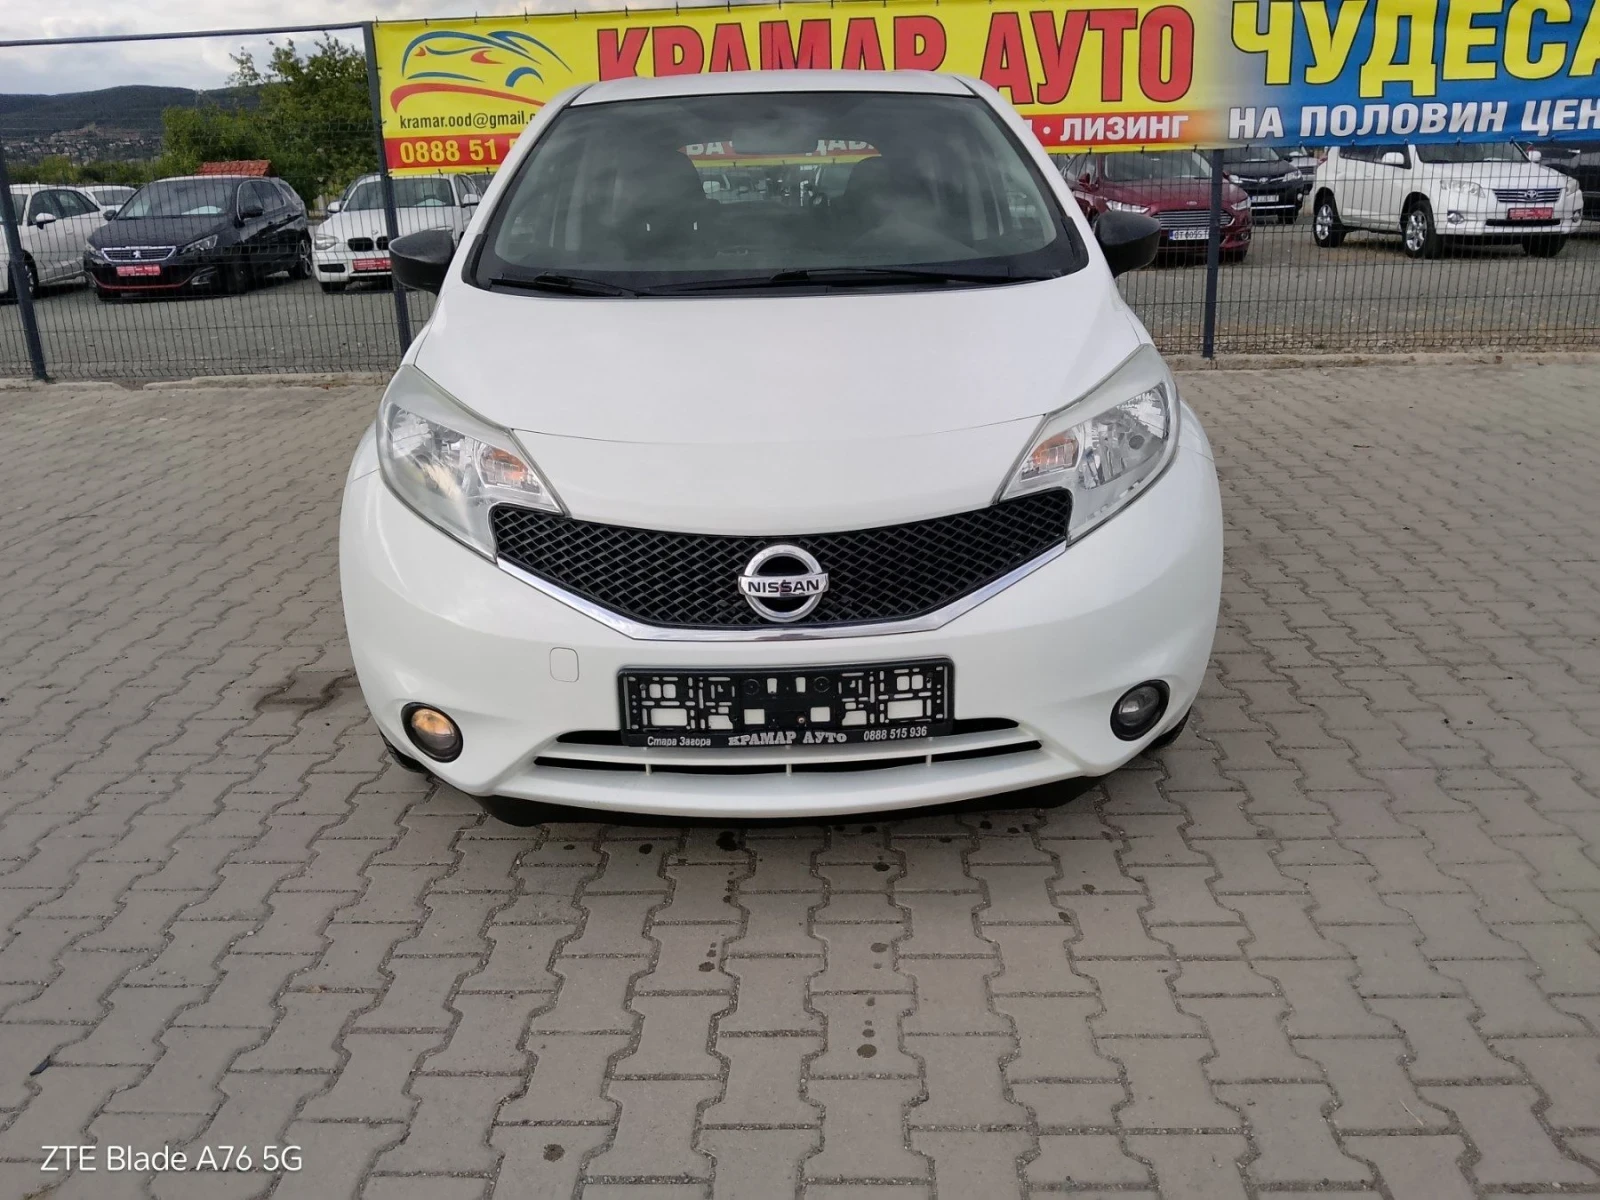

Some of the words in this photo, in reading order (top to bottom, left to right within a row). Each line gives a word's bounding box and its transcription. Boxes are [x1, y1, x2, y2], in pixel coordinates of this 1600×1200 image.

[980, 5, 1194, 104] АУТО
[1059, 116, 1189, 141] ЛИЗИНГ
[1228, 107, 1285, 139] НА
[1300, 101, 1508, 137] ПОЛОВИН
[400, 139, 460, 163] 0888
[748, 579, 819, 593] NISSAN
[647, 736, 677, 747] Стара
[679, 736, 711, 747] Загора
[728, 731, 796, 746] КРАМАР
[802, 731, 847, 744] АУТО
[863, 729, 887, 741] 0888
[889, 727, 907, 739] 515
[909, 726, 927, 738] 936
